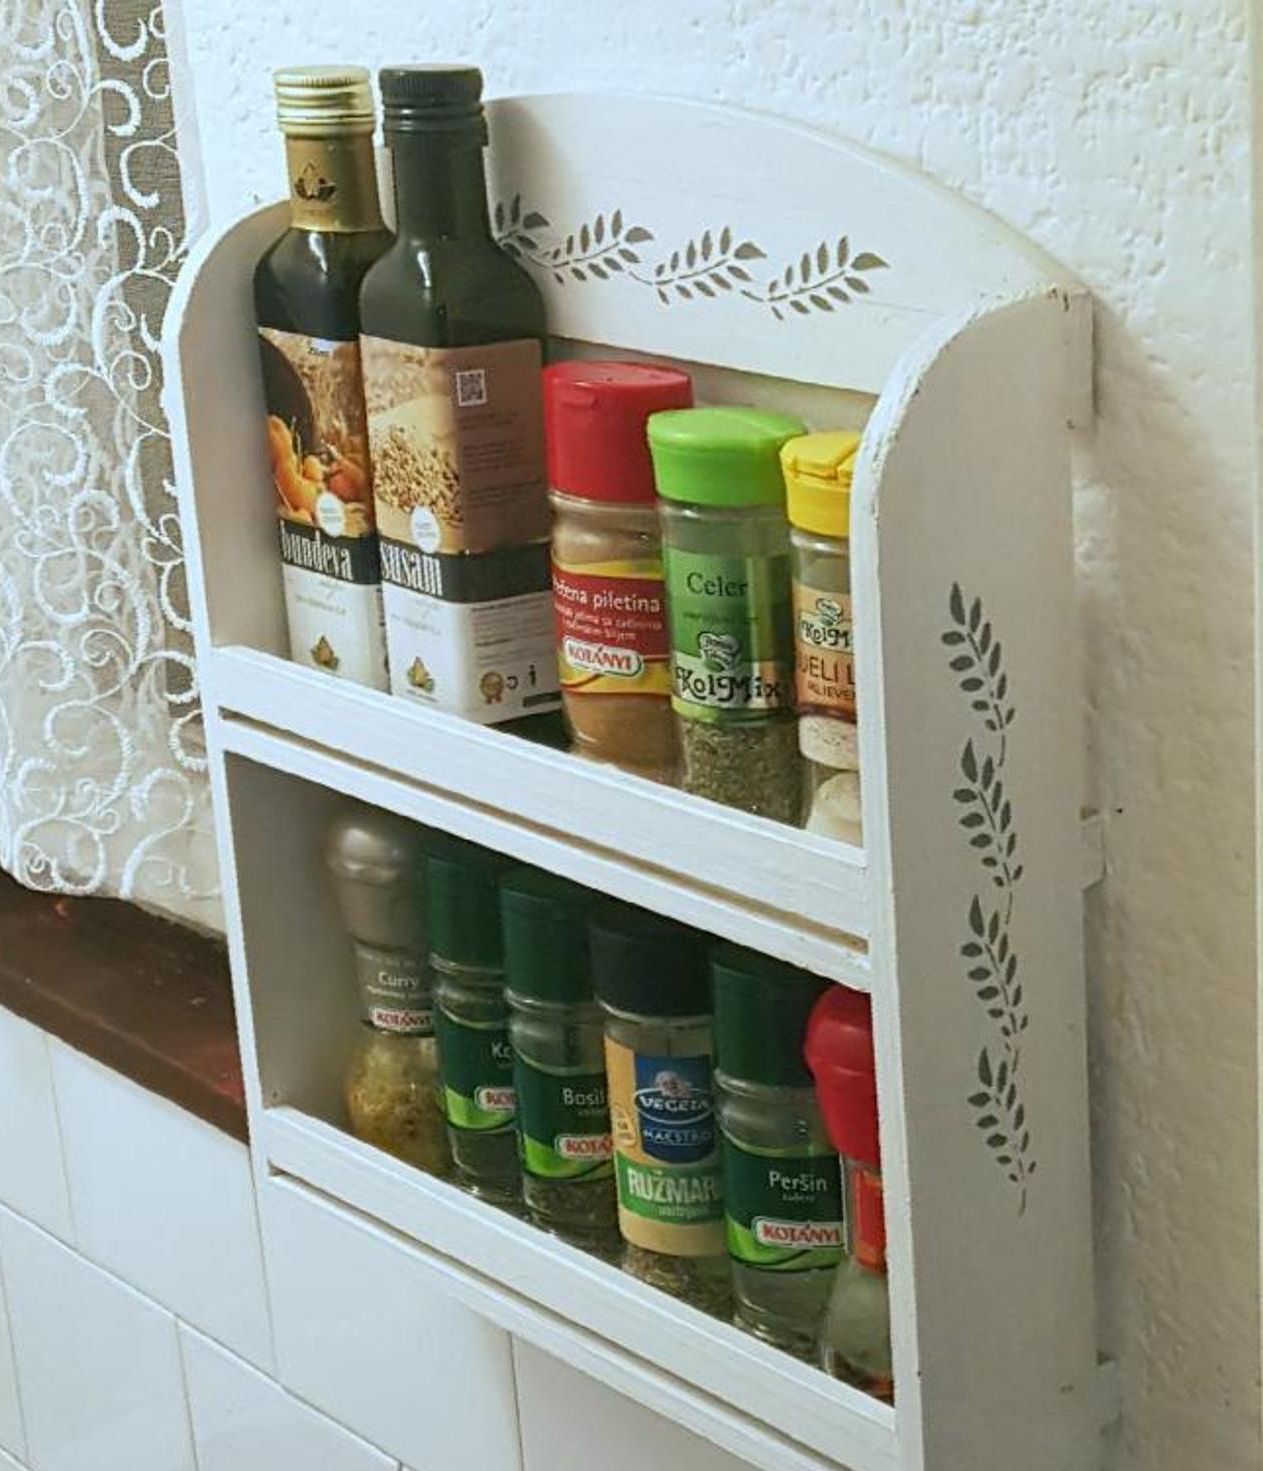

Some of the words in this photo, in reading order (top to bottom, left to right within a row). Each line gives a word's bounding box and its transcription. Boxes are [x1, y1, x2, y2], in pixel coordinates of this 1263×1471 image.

[280, 519, 353, 580] bundeva
[379, 541, 443, 597] susam
[687, 572, 748, 597] Celer
[593, 588, 660, 613] piletina
[377, 970, 419, 990] Curry
[769, 1170, 828, 1192] Peršin
